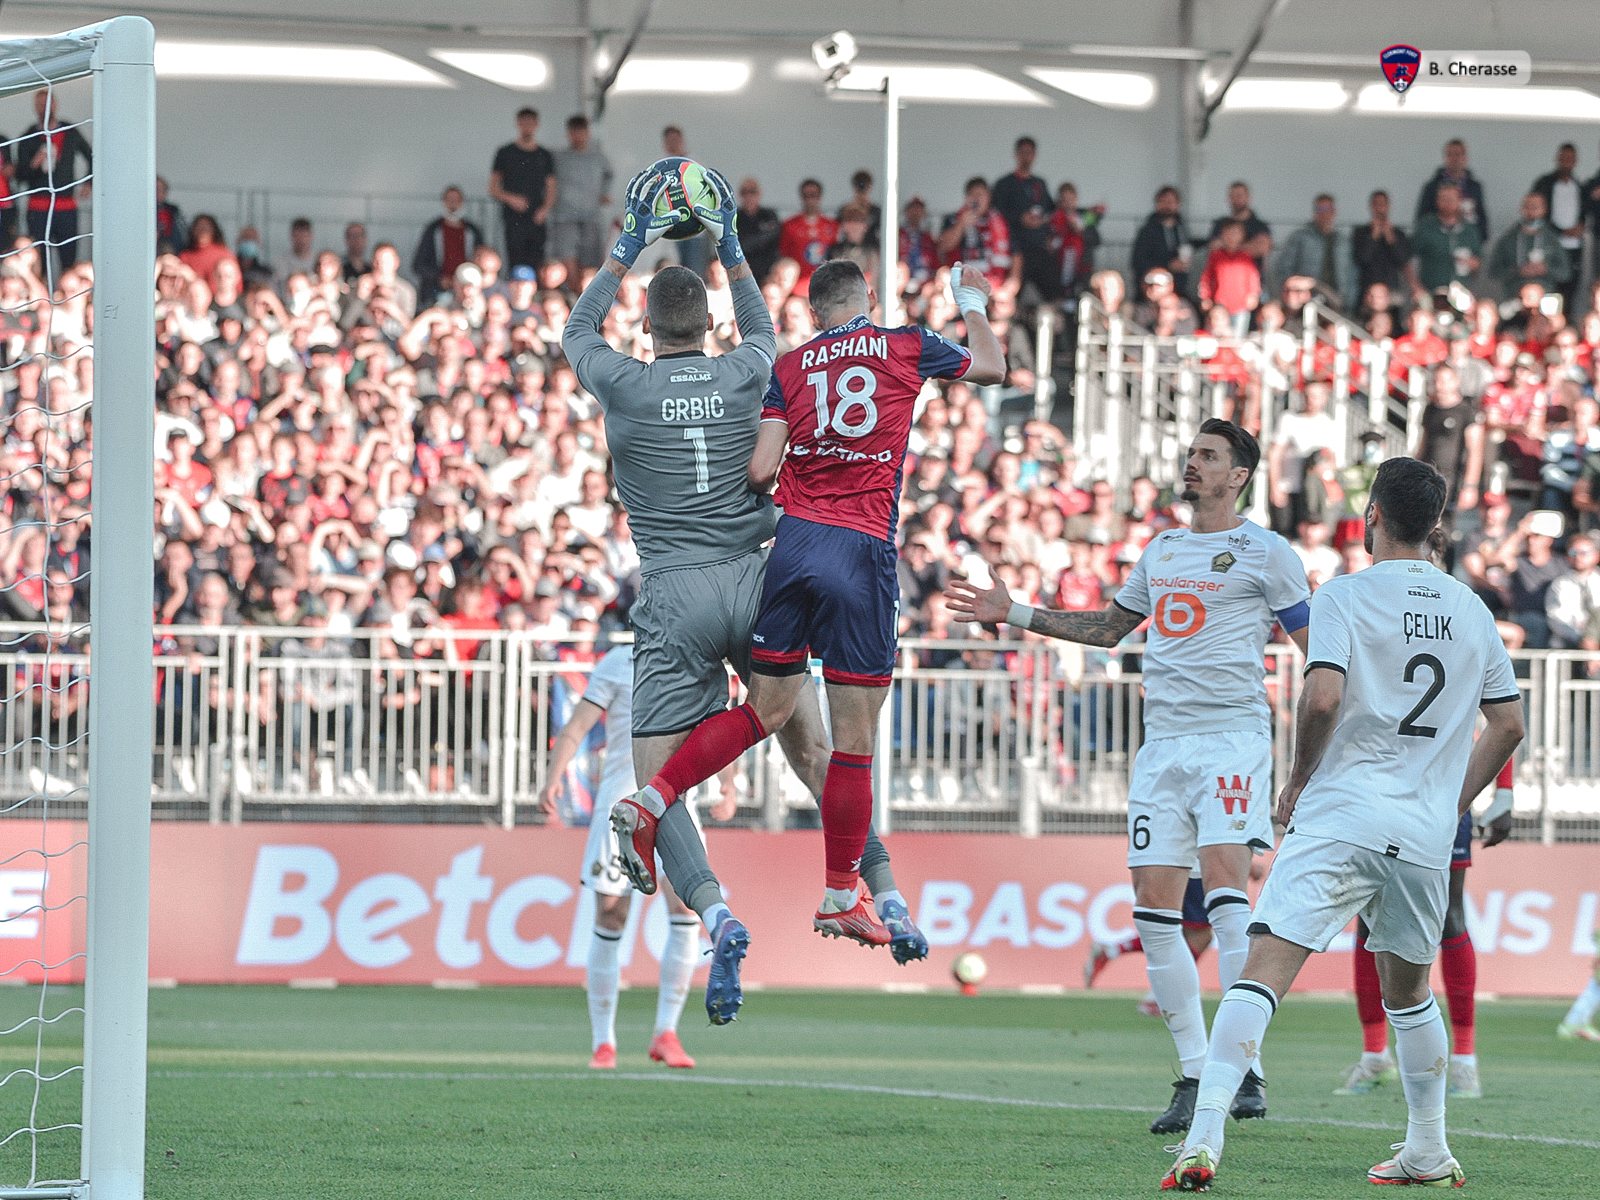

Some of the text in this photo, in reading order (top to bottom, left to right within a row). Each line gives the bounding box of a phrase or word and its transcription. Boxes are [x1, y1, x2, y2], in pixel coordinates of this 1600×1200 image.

[801, 335, 888, 370] RASHANI
[661, 390, 724, 422] GRBIĆ
[806, 366, 878, 439] 18
[683, 427, 709, 494] 1
[1151, 576, 1225, 593] boulanger
[1403, 611, 1453, 644] ÇELIK
[1397, 653, 1446, 739] 2
[1133, 814, 1151, 850] 6
